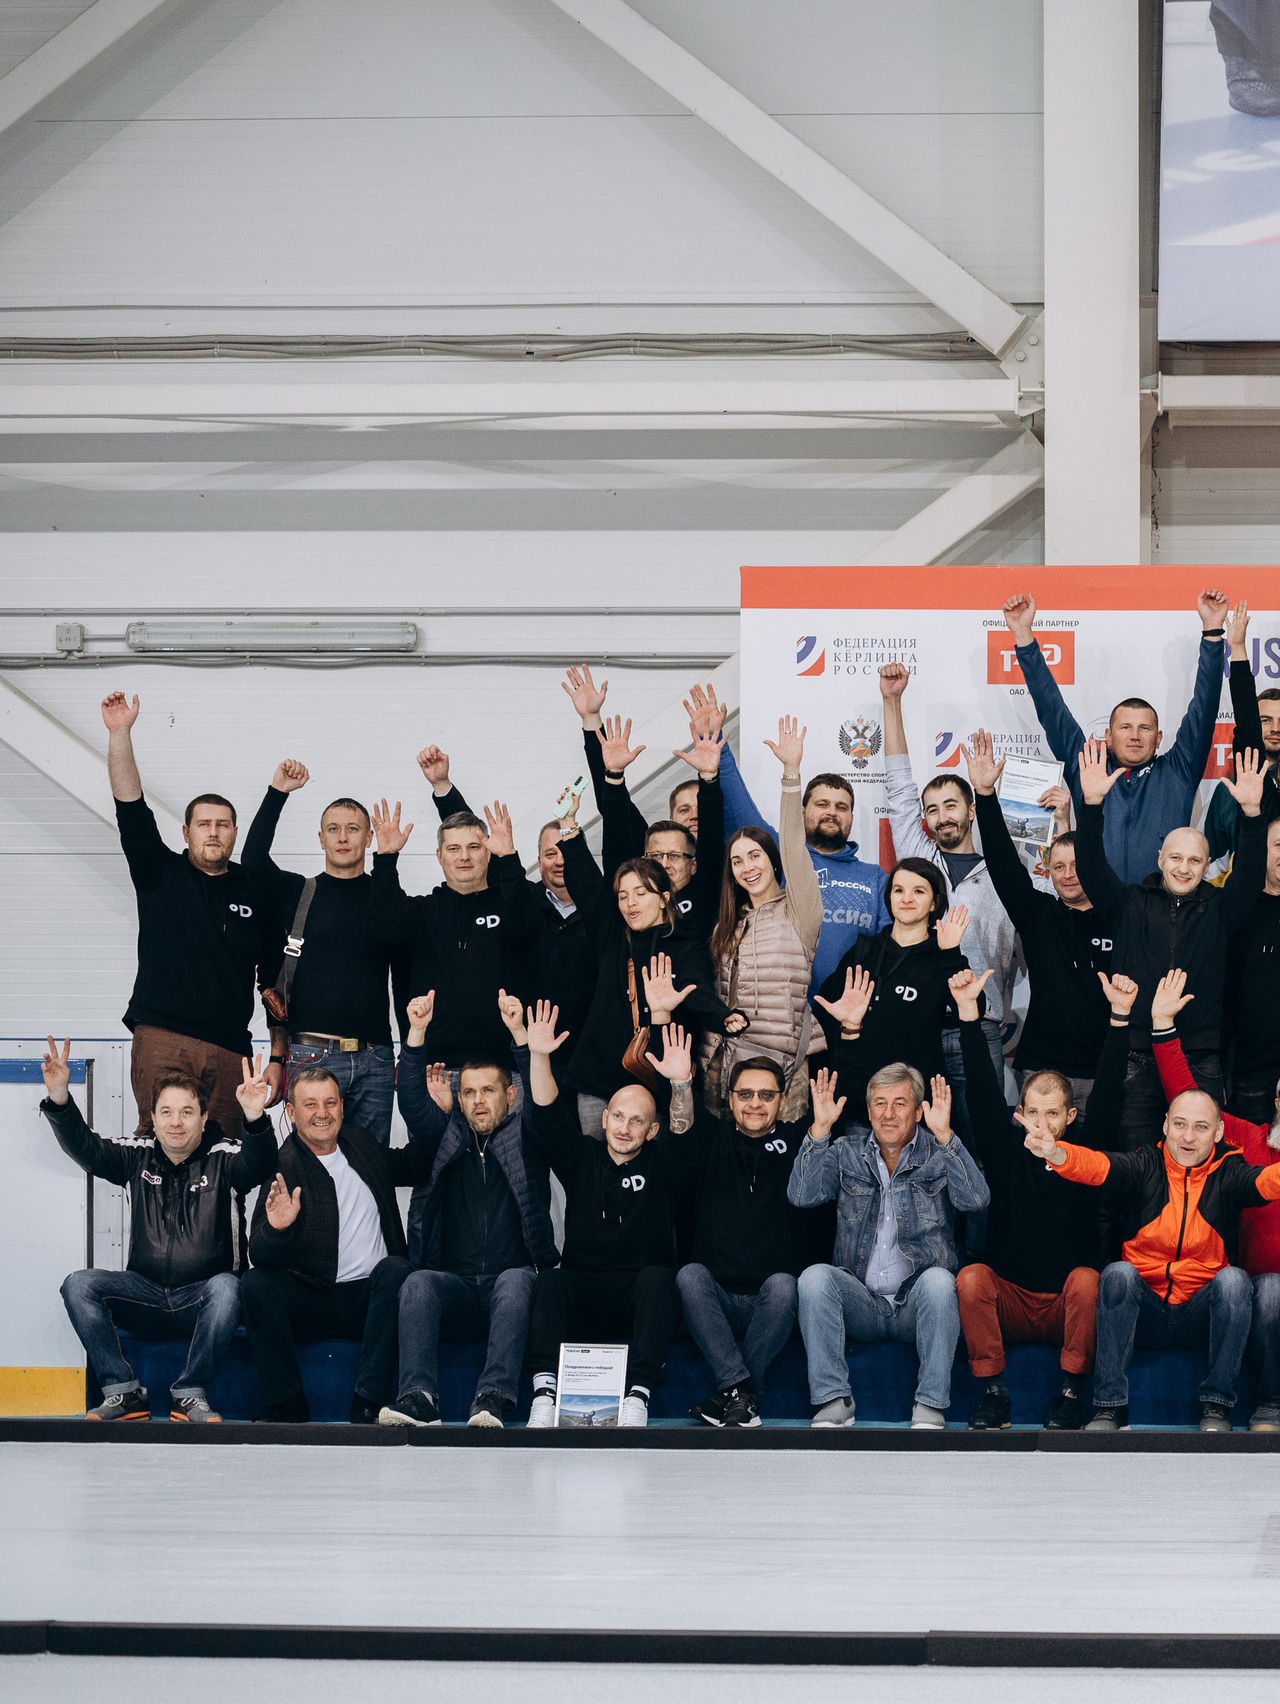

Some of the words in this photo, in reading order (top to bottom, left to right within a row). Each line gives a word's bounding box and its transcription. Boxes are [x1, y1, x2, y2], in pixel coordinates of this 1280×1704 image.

[833, 638, 917, 650] ФЕДЕРАЦИЯ
[833, 650, 917, 662] КЁРЛИНГА
[831, 880, 872, 894] РОССИЯ
[823, 909, 872, 929] ССИЯ
